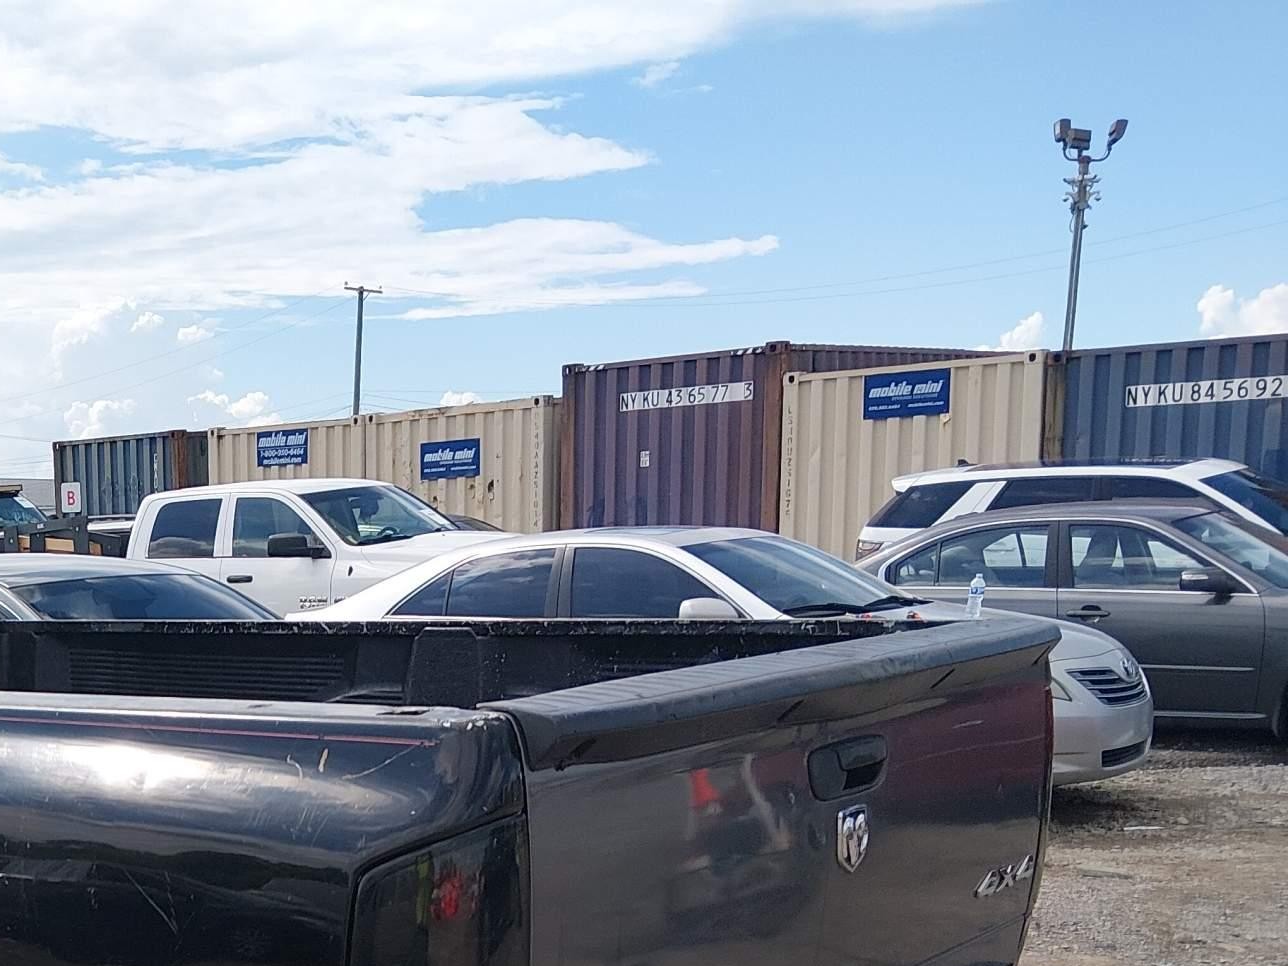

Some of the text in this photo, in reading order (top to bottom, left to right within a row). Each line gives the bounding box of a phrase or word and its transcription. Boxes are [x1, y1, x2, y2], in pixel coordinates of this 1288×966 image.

[743, 382, 753, 400] 3
[868, 381, 912, 398] mobile
[913, 380, 944, 395] mini
[258, 431, 286, 447] mobile
[423, 447, 454, 462] mobile
[67, 490, 76, 506] B
